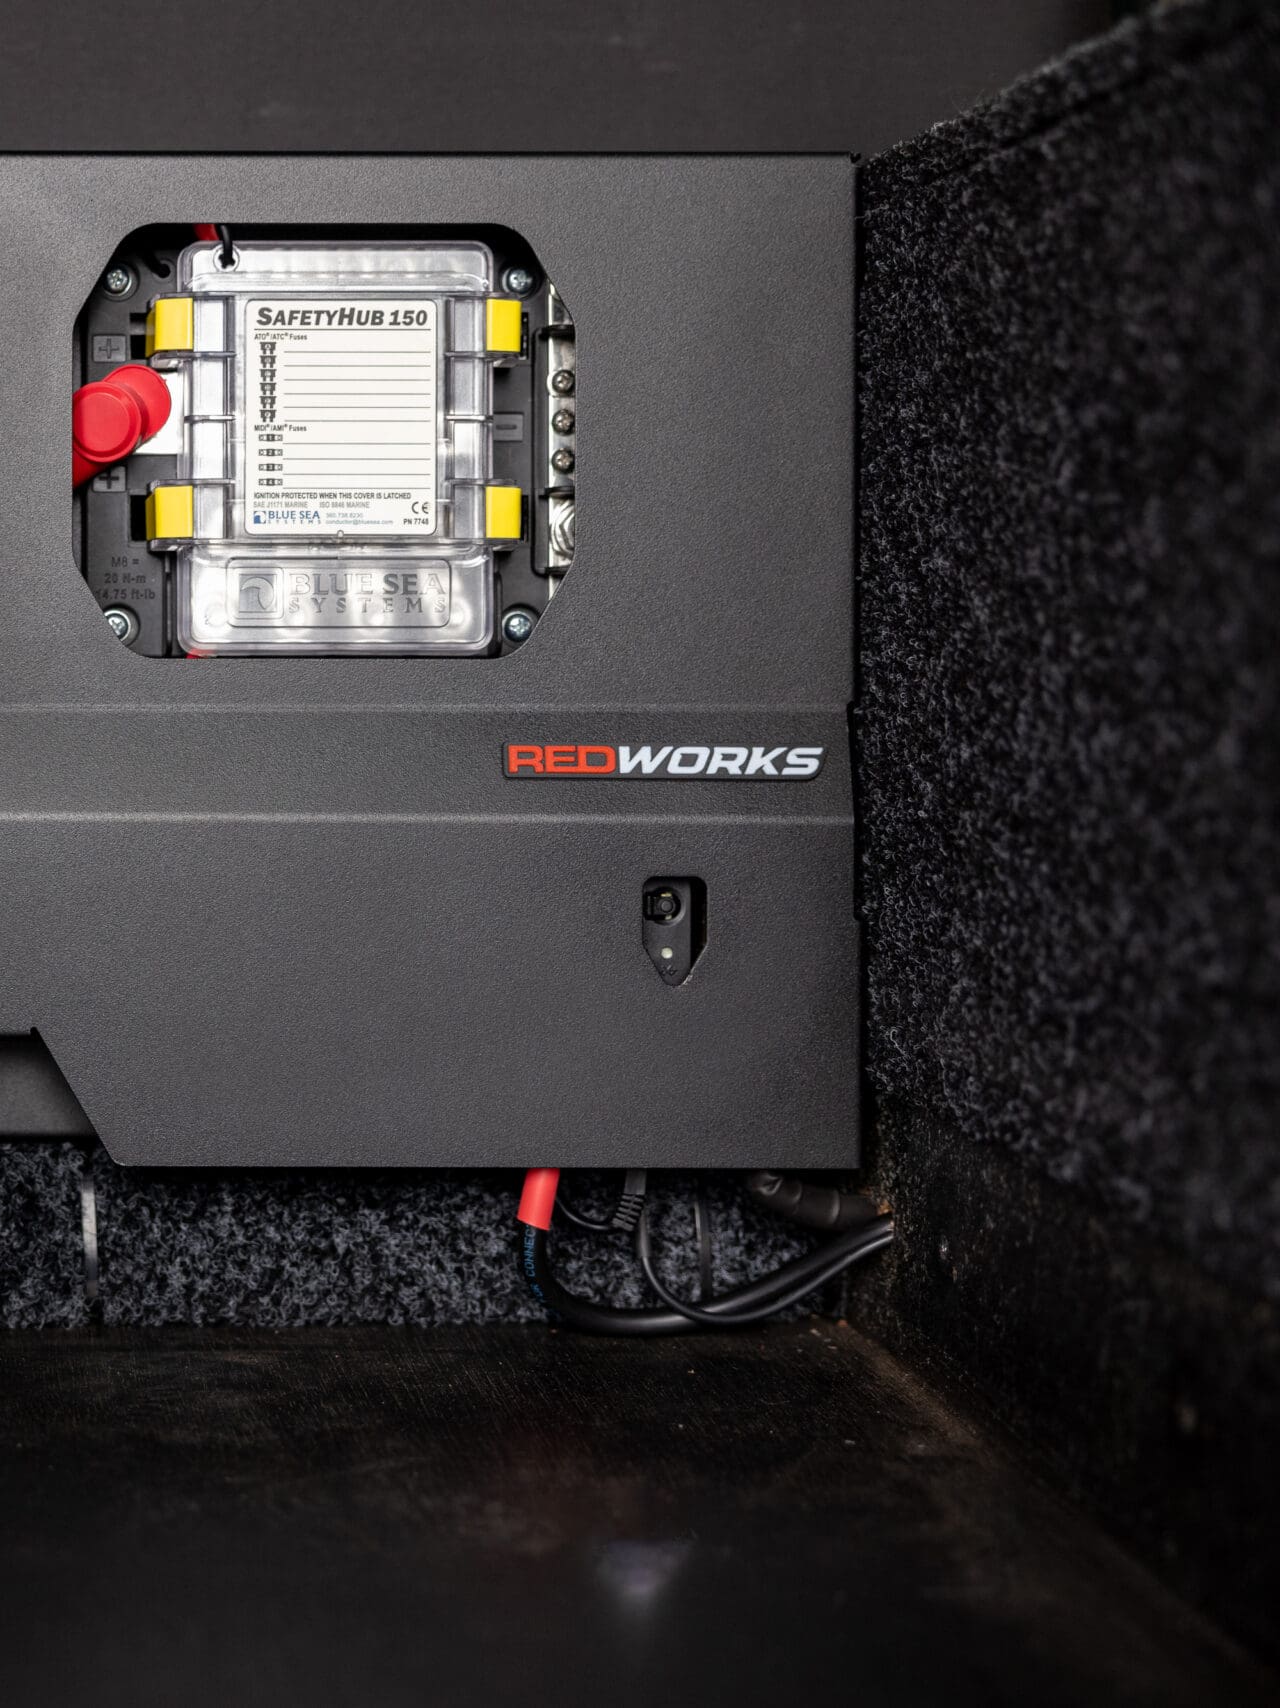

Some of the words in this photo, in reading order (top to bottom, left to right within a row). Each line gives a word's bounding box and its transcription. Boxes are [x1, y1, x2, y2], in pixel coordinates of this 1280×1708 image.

[389, 309, 428, 326] 150
[268, 510, 297, 519] BLUE
[299, 510, 320, 519] SEA
[111, 556, 128, 567] M8
[289, 573, 374, 595] BLUE
[382, 573, 446, 595] SEA
[288, 597, 447, 613] SYSTEMS
[508, 745, 825, 775] REDWORKS
